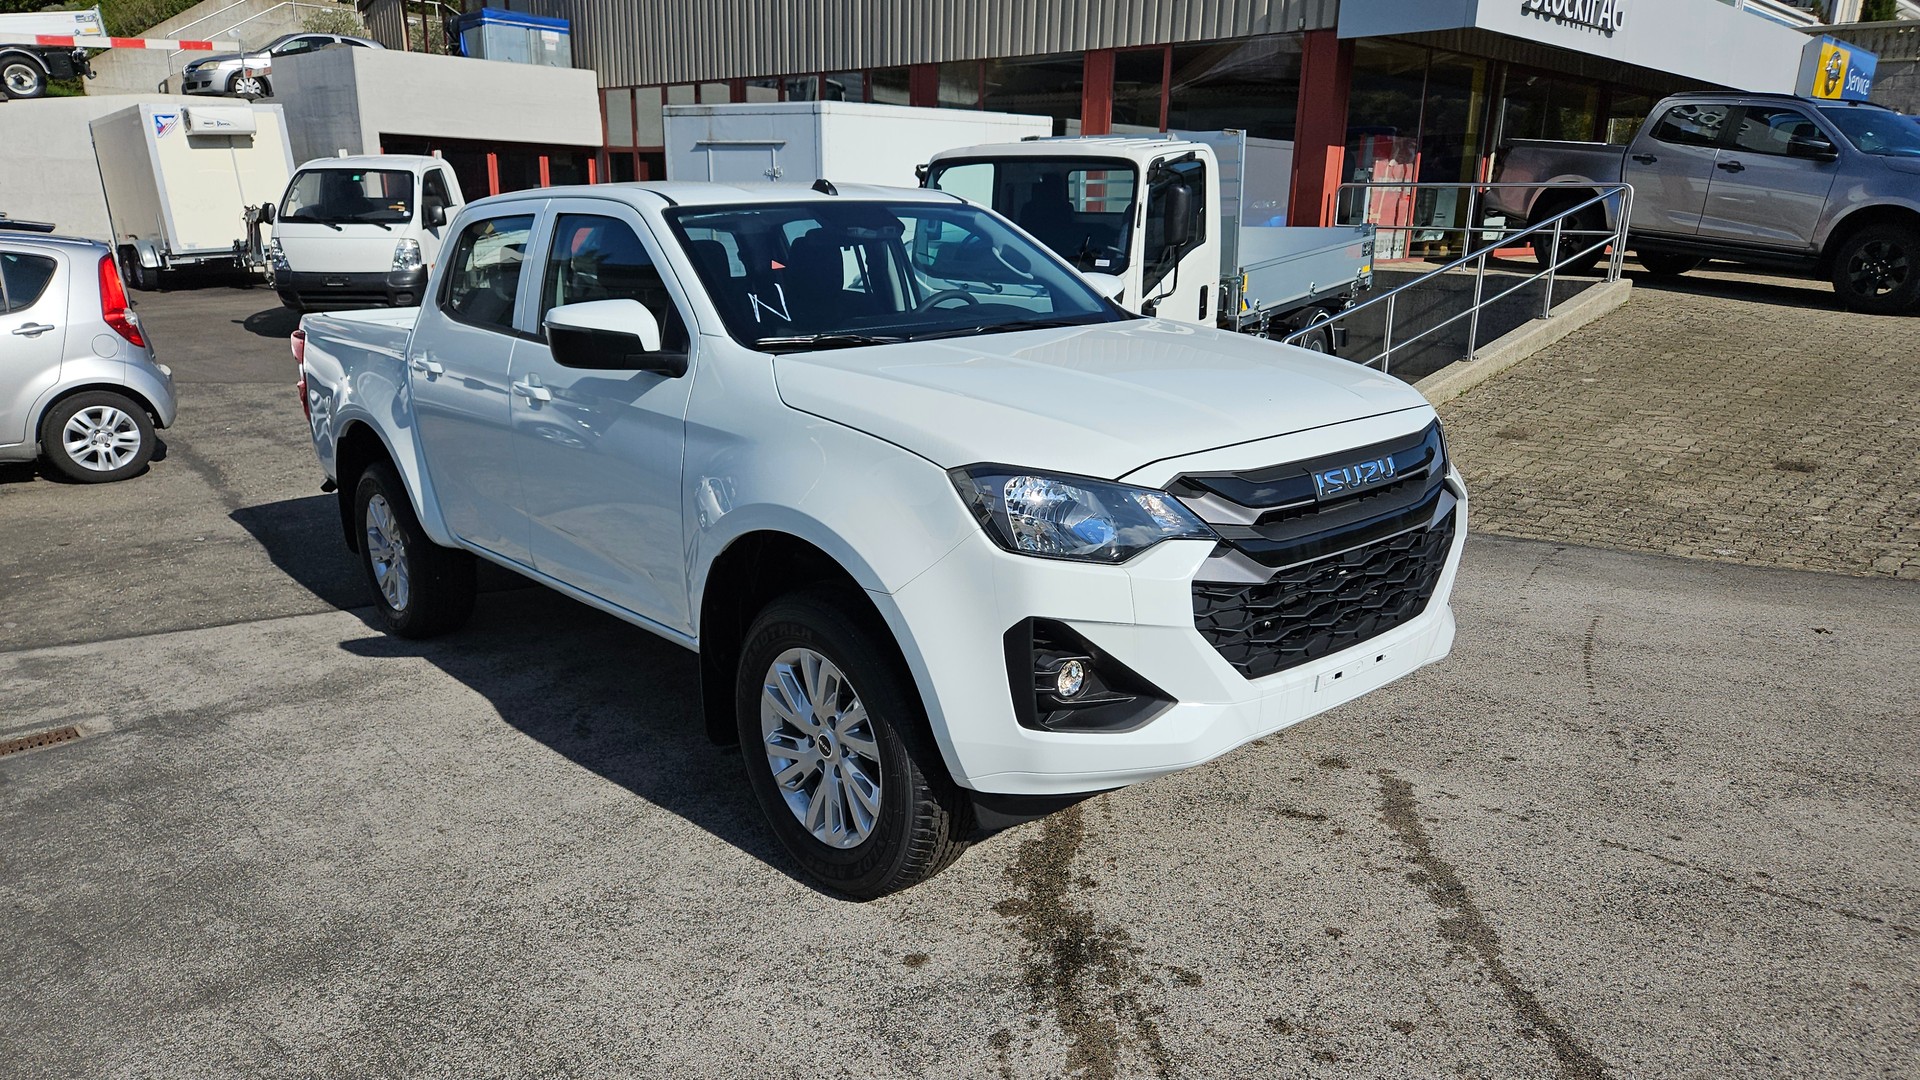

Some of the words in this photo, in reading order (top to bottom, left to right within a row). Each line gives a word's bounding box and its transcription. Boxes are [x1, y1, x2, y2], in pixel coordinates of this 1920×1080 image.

[1598, 0, 1626, 32] AG
[1845, 67, 1870, 96] Service
[747, 282, 792, 323] N
[1315, 455, 1395, 497] ISUZU
